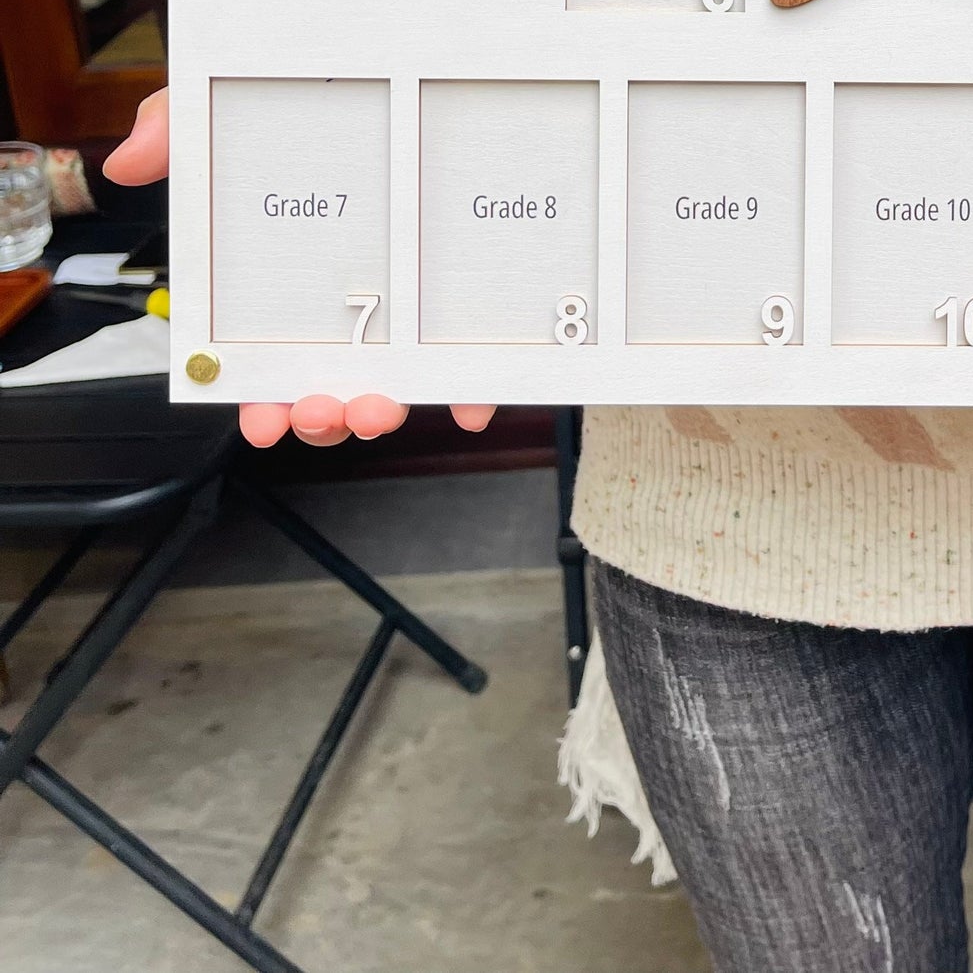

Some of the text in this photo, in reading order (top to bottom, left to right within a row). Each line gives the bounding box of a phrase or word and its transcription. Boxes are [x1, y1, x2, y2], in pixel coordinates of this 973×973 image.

[263, 192, 348, 218] Grade 7
[472, 194, 557, 219] Grade 8
[675, 195, 758, 221] Grade 9
[875, 196, 971, 222] Grade 10
[345, 294, 380, 344] 7
[554, 294, 589, 345] 8
[760, 294, 795, 346] 9
